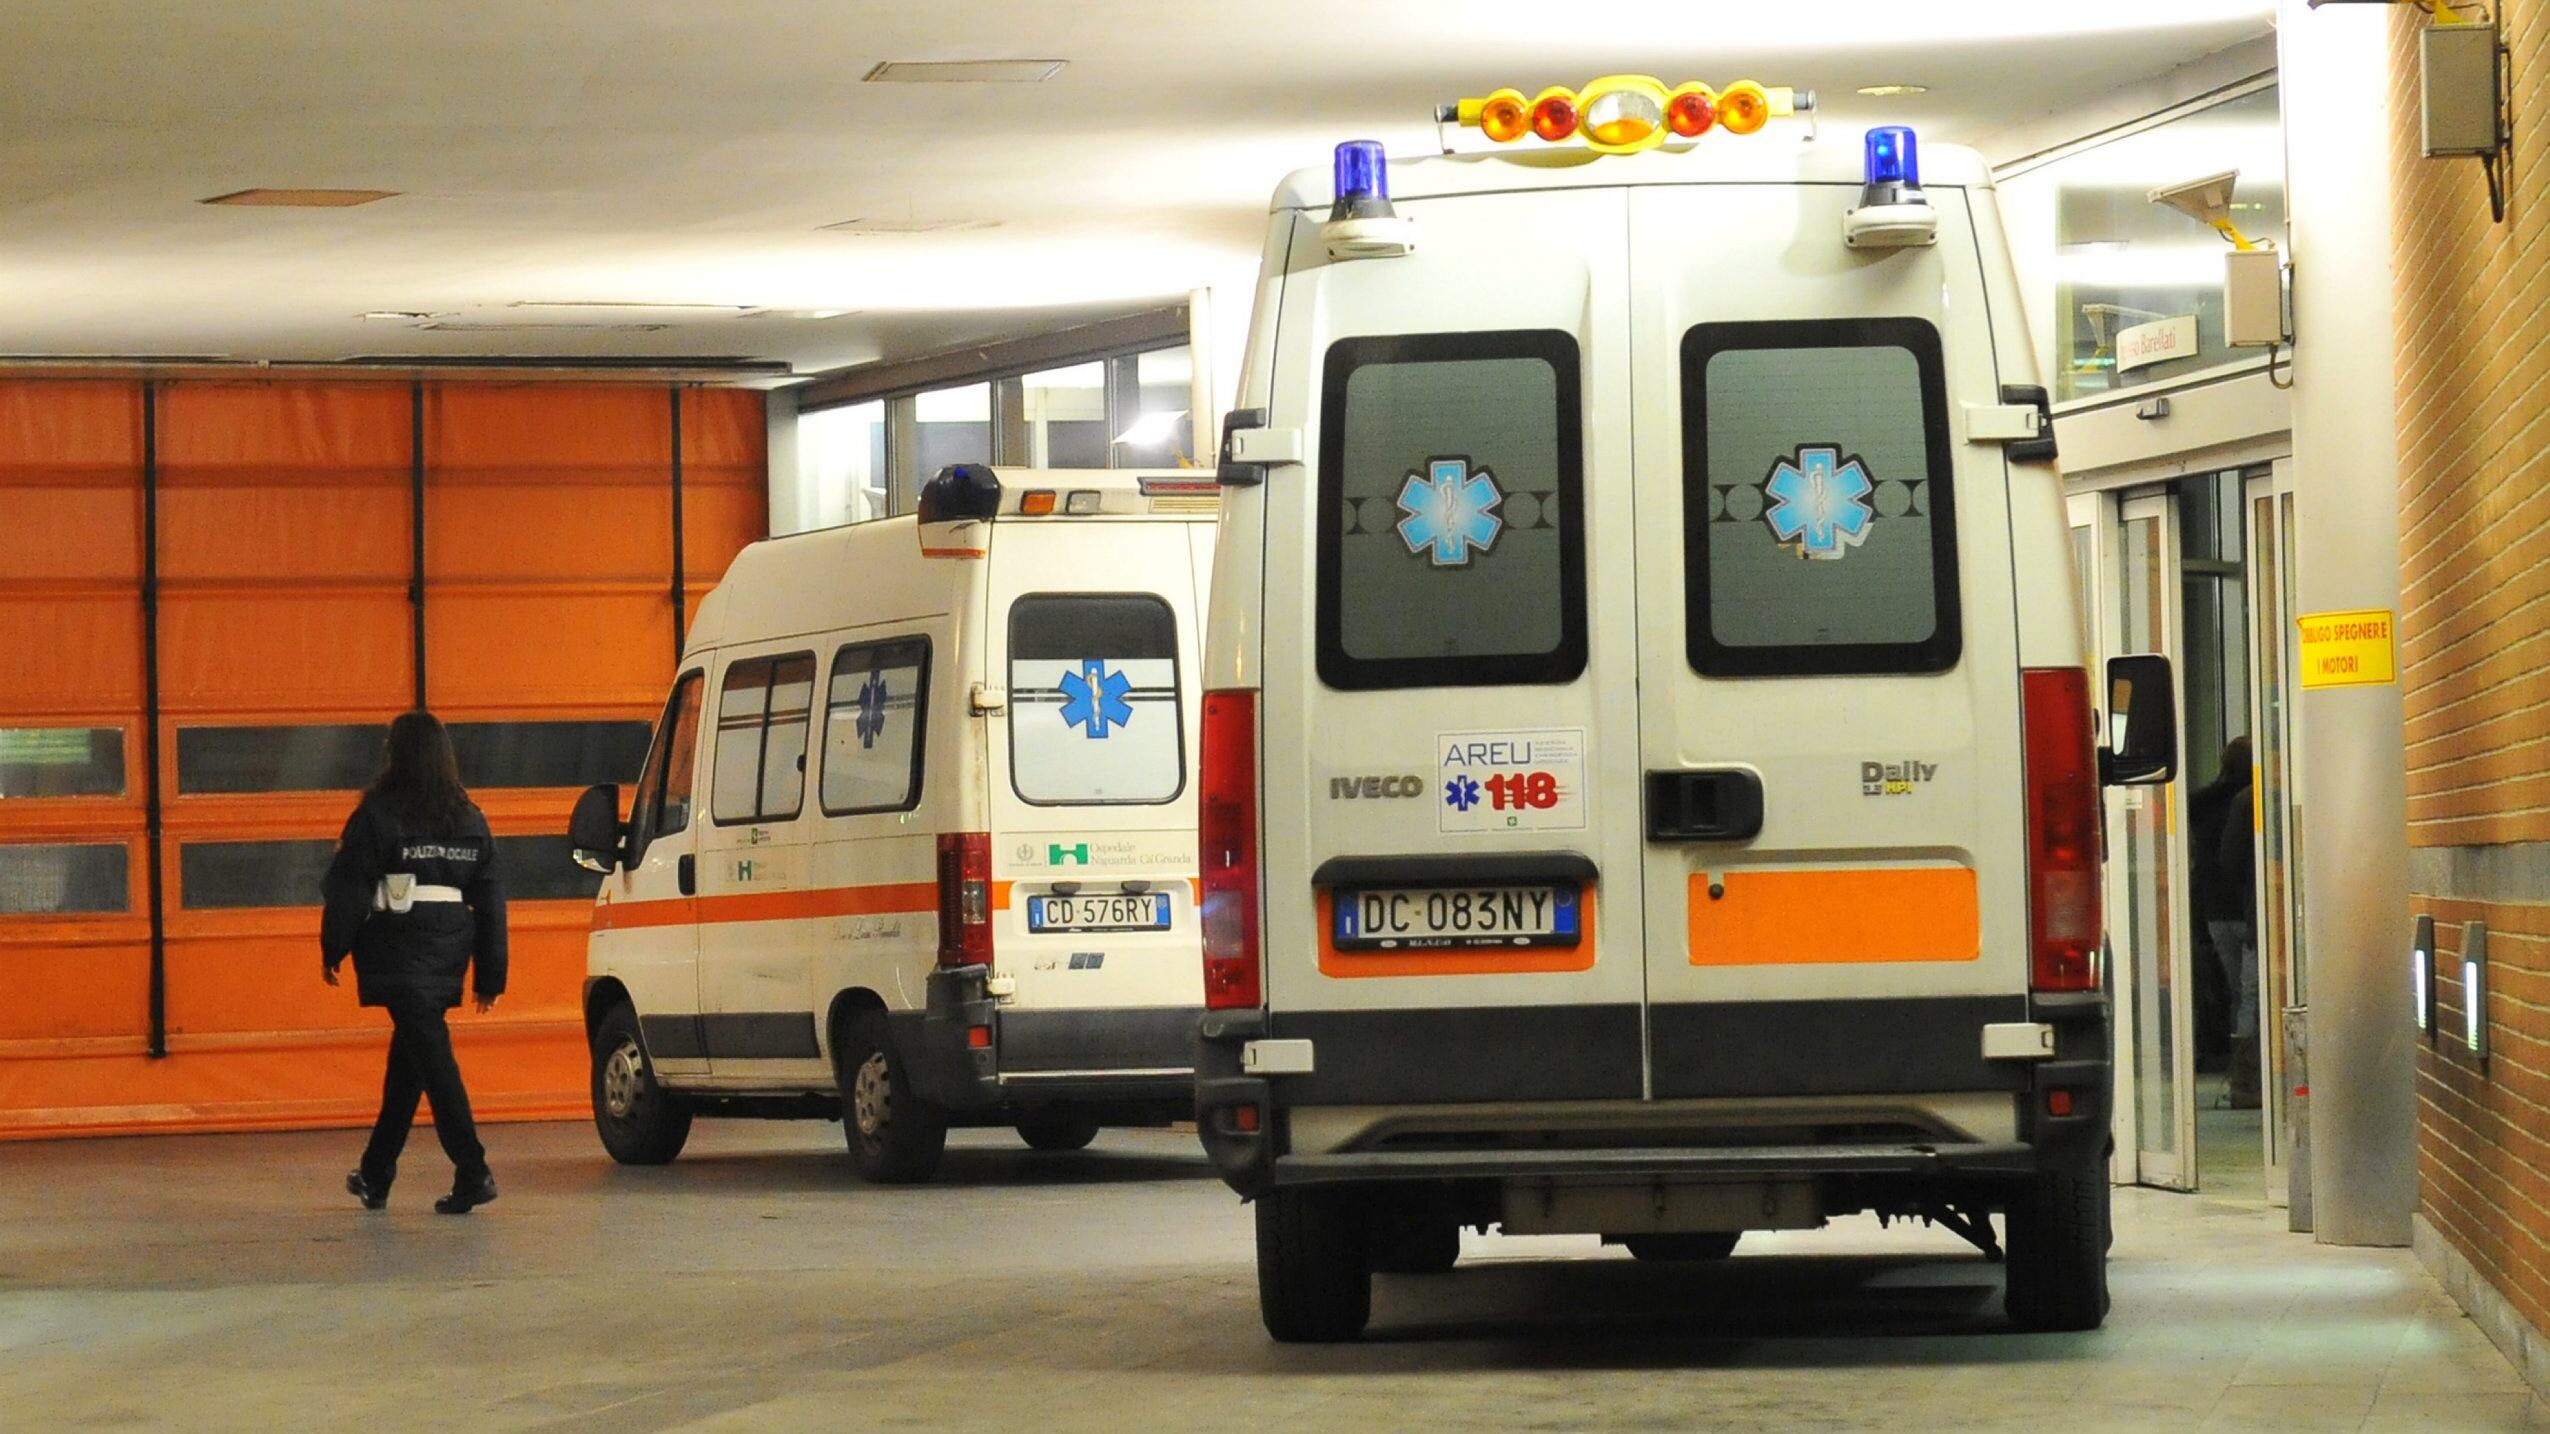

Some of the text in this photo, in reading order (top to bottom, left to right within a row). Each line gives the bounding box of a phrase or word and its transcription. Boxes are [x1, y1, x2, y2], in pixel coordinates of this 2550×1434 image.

[2334, 621, 2387, 642] SPEGNERE
[2322, 656, 2359, 674] MOTORI
[1444, 741, 1531, 767] AREU
[1862, 760, 1938, 783] Daily
[1330, 775, 1424, 800] IVECO
[1484, 771, 1559, 811] 118
[1046, 898, 1152, 924] CD 576RY
[1365, 891, 1547, 933] DC 083NY
